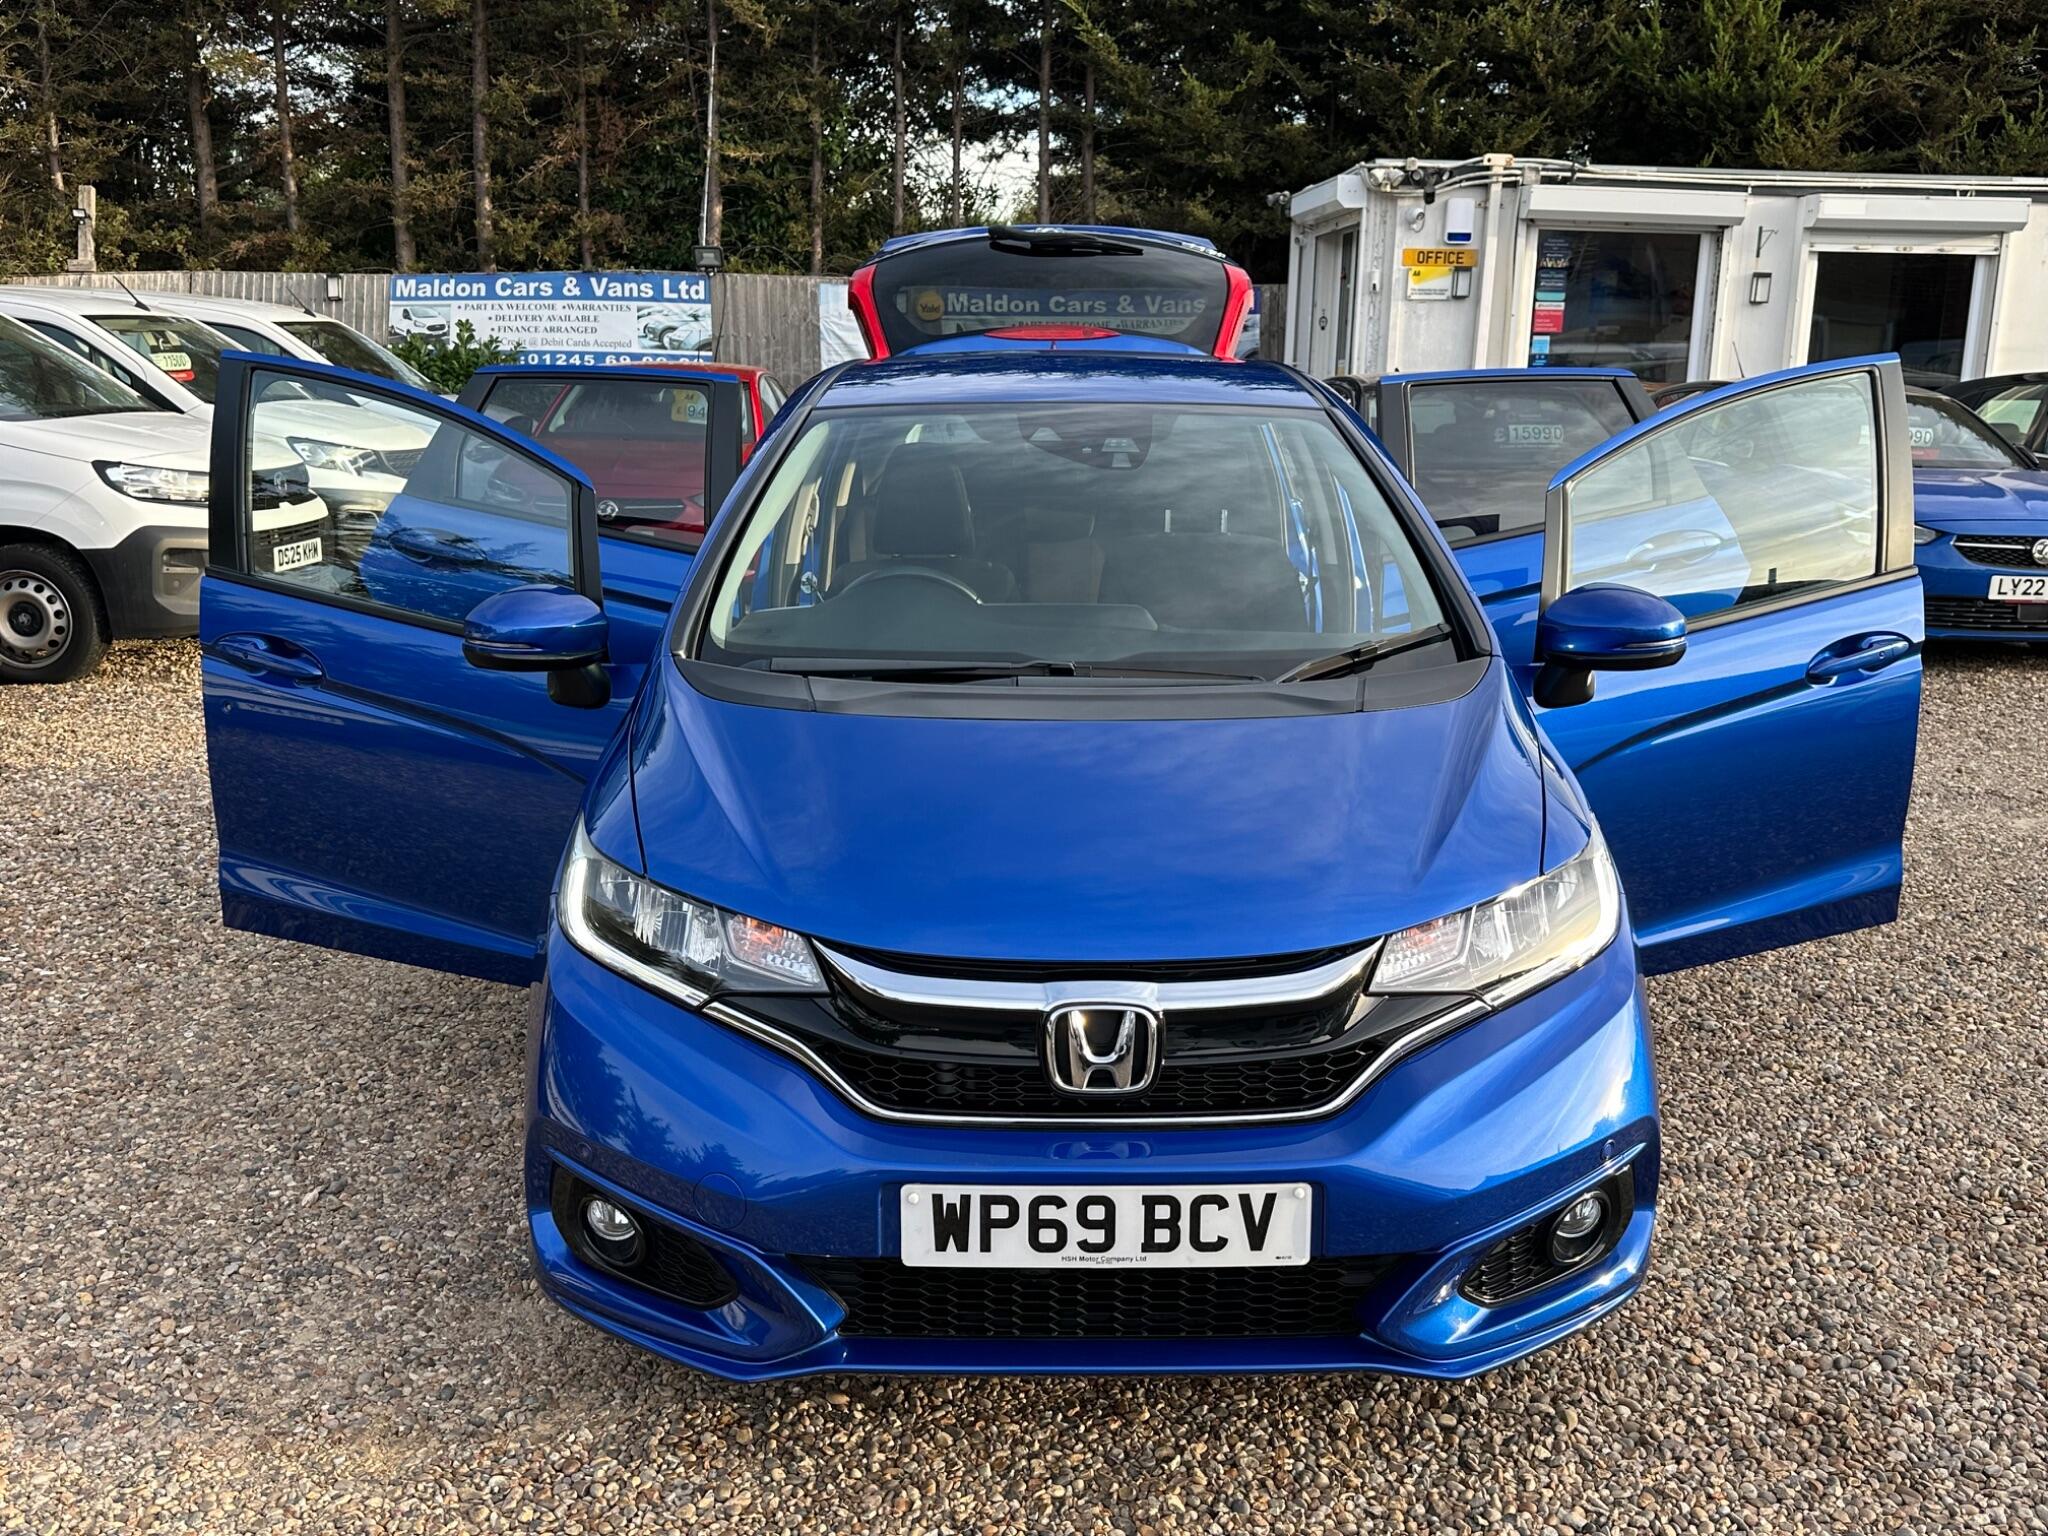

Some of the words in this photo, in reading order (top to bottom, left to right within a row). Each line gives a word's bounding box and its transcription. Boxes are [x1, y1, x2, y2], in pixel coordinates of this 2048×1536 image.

[1416, 250, 1465, 265] OFFICE
[395, 278, 486, 298] Maldon
[495, 277, 553, 297] Cars
[562, 277, 582, 297] &
[590, 278, 654, 299] Vans
[662, 279, 706, 300] Ltd
[464, 303, 487, 311] PART
[491, 303, 504, 311] EX
[507, 303, 557, 311] WELCOME
[948, 293, 1040, 313] Maldon
[1049, 296, 1107, 314] Cars
[1117, 295, 1136, 313] &
[1145, 296, 1206, 314] Vans
[495, 314, 543, 322] DELIVERY
[546, 314, 600, 323] AVAILABLE
[498, 325, 540, 334] FINANCE
[543, 325, 598, 334] ARRANGED
[541, 338, 564, 347] Debit
[566, 338, 591, 348] Cards
[593, 339, 632, 349] Accepted
[278, 545, 302, 567] DS25
[1997, 578, 2046, 596] LY22
[931, 1193, 1117, 1253] WP69
[1141, 1192, 1278, 1253] BCV
[1100, 1255, 1134, 1264] Company
